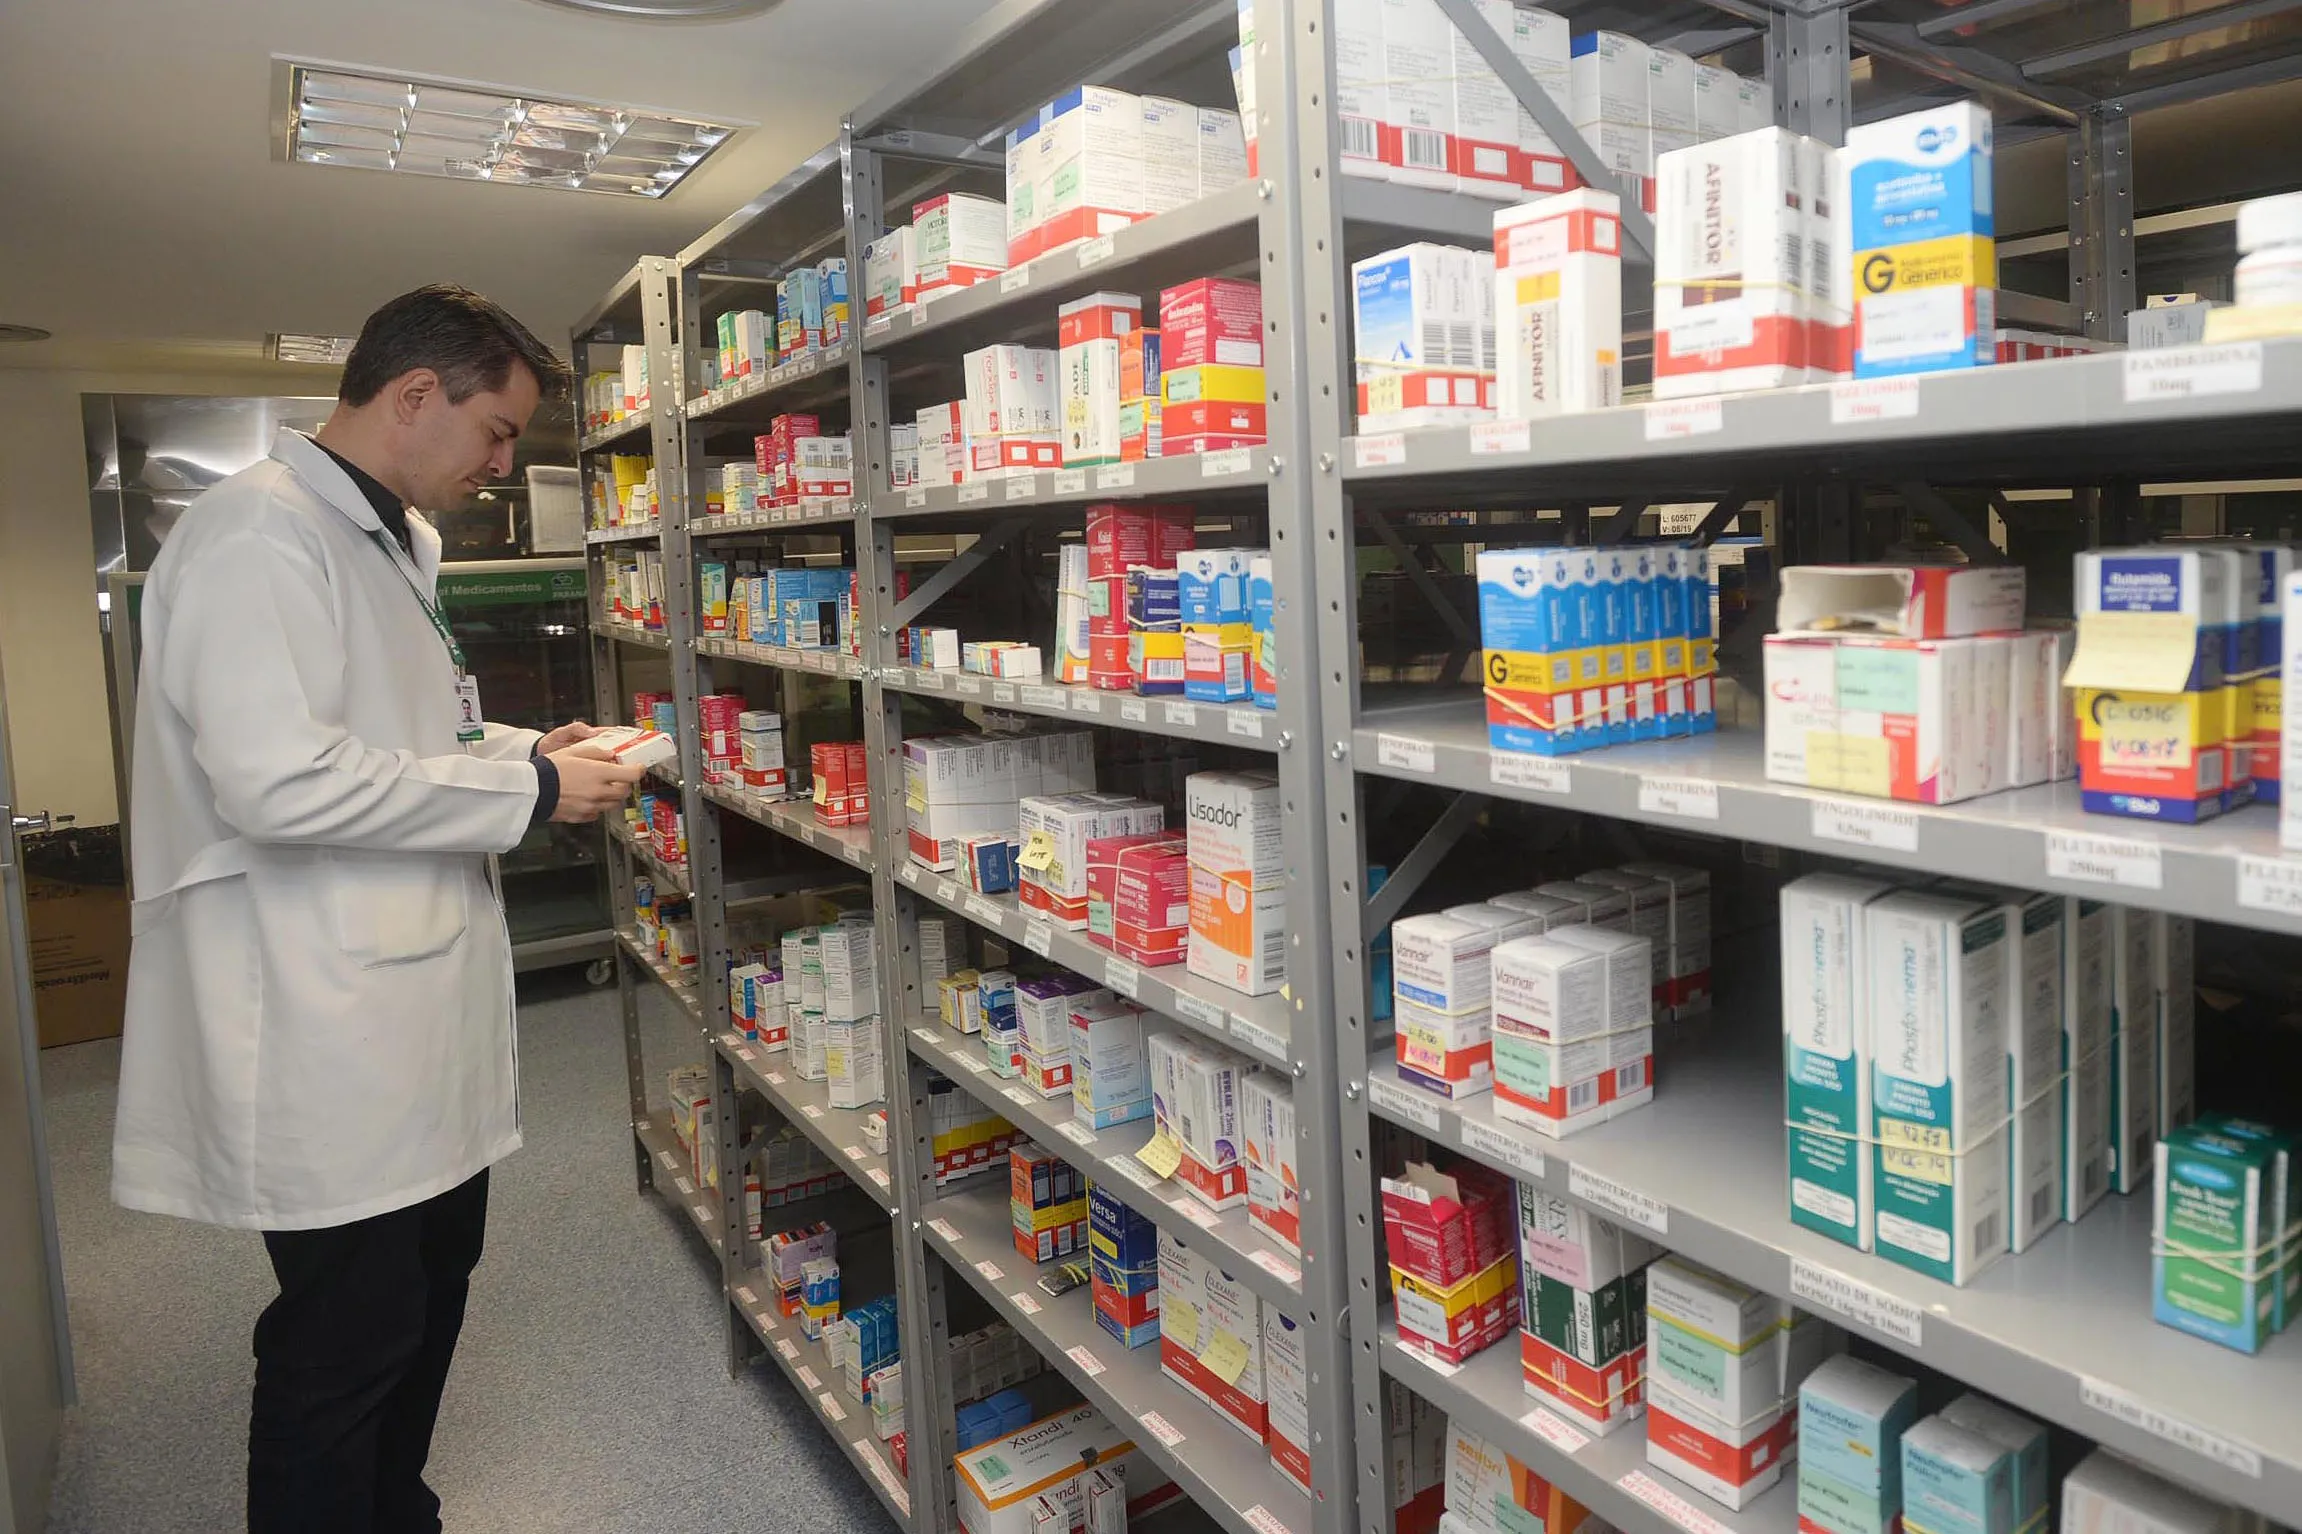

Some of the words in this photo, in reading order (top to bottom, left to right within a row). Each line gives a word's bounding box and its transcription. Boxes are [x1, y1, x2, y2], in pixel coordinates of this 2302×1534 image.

[1704, 162, 1724, 267] AFINITOR
[1863, 254, 1895, 292] G
[1532, 311, 1546, 402] AFINITOR
[1670, 514, 1697, 523] 605677
[451, 583, 542, 596] Medicamentos
[1489, 653, 1508, 685] G
[1189, 797, 1243, 830] Lisador
[1396, 941, 1430, 963] Vannair
[1494, 965, 1537, 991] Vannair
[1088, 1194, 1117, 1225] Versa
[1578, 1300, 1591, 1328] 250
[1577, 1329, 1590, 1351] mg
[1804, 1401, 1860, 1431] Neutrofer
[1008, 1421, 1065, 1450] Xtandi
